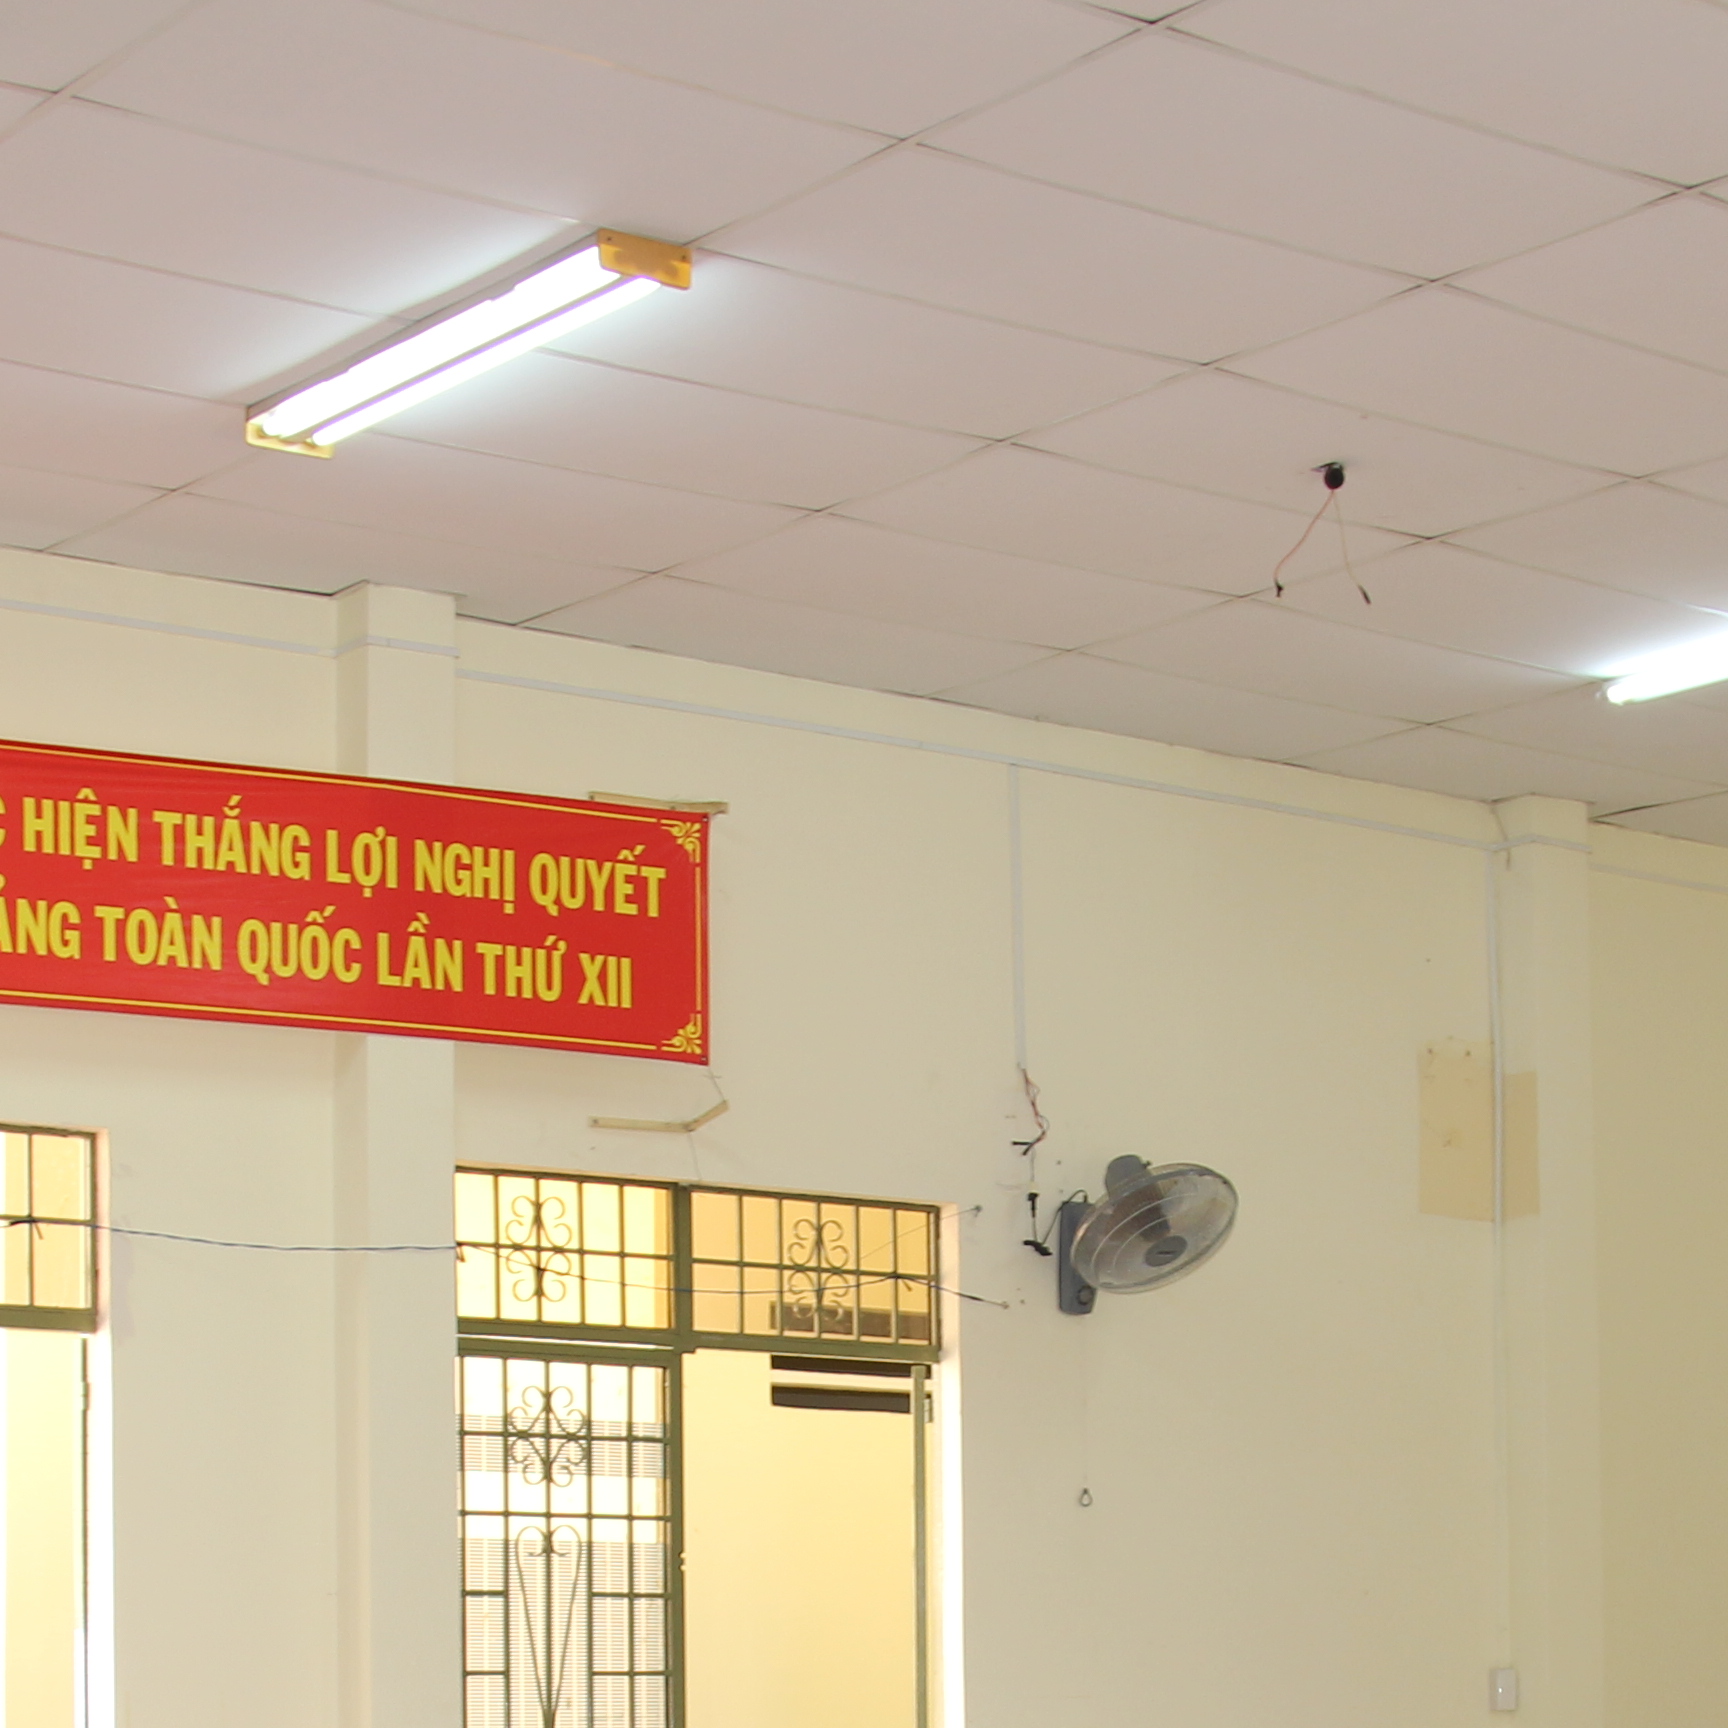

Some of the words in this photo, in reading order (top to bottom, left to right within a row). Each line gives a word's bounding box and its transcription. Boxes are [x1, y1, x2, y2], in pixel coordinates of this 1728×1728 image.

[23, 788, 138, 869] HIỆN
[153, 795, 310, 880] THẮNG
[326, 827, 397, 897] LỢI
[415, 840, 514, 914] NGHỊ
[530, 843, 666, 917] QUYẾT
[94, 897, 222, 970] TOÀN
[237, 905, 361, 985] QUỐC
[378, 912, 463, 992] LẦN
[476, 934, 566, 1002] THỨ
[578, 953, 631, 1008] XII
